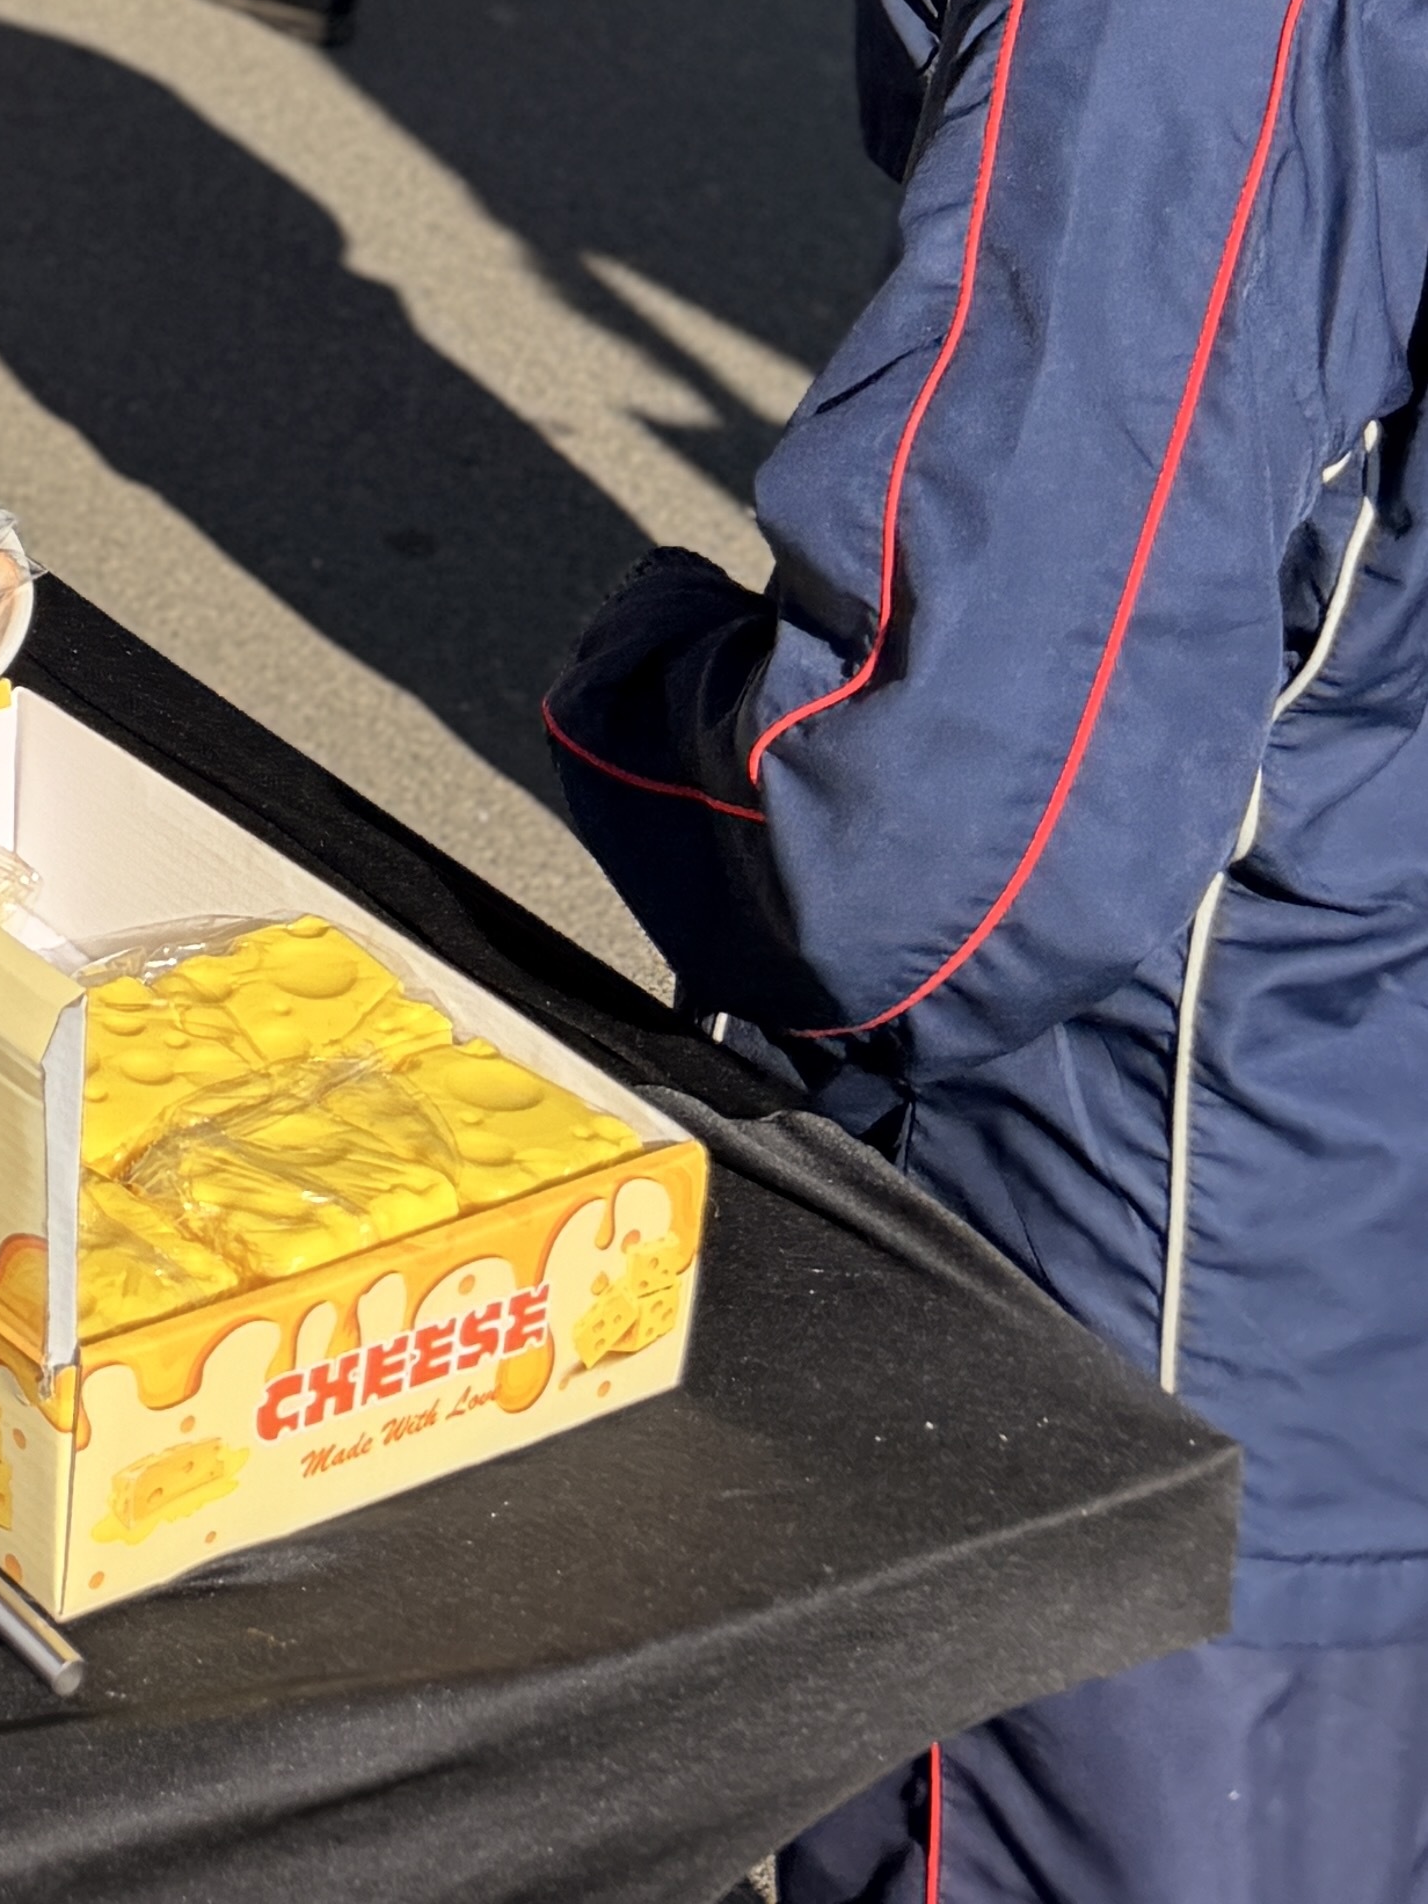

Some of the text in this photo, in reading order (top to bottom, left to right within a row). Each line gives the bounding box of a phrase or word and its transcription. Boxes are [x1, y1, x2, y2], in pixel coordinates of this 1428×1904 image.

[257, 1284, 550, 1441] CHEESE
[300, 1383, 502, 1479] Made With Love
